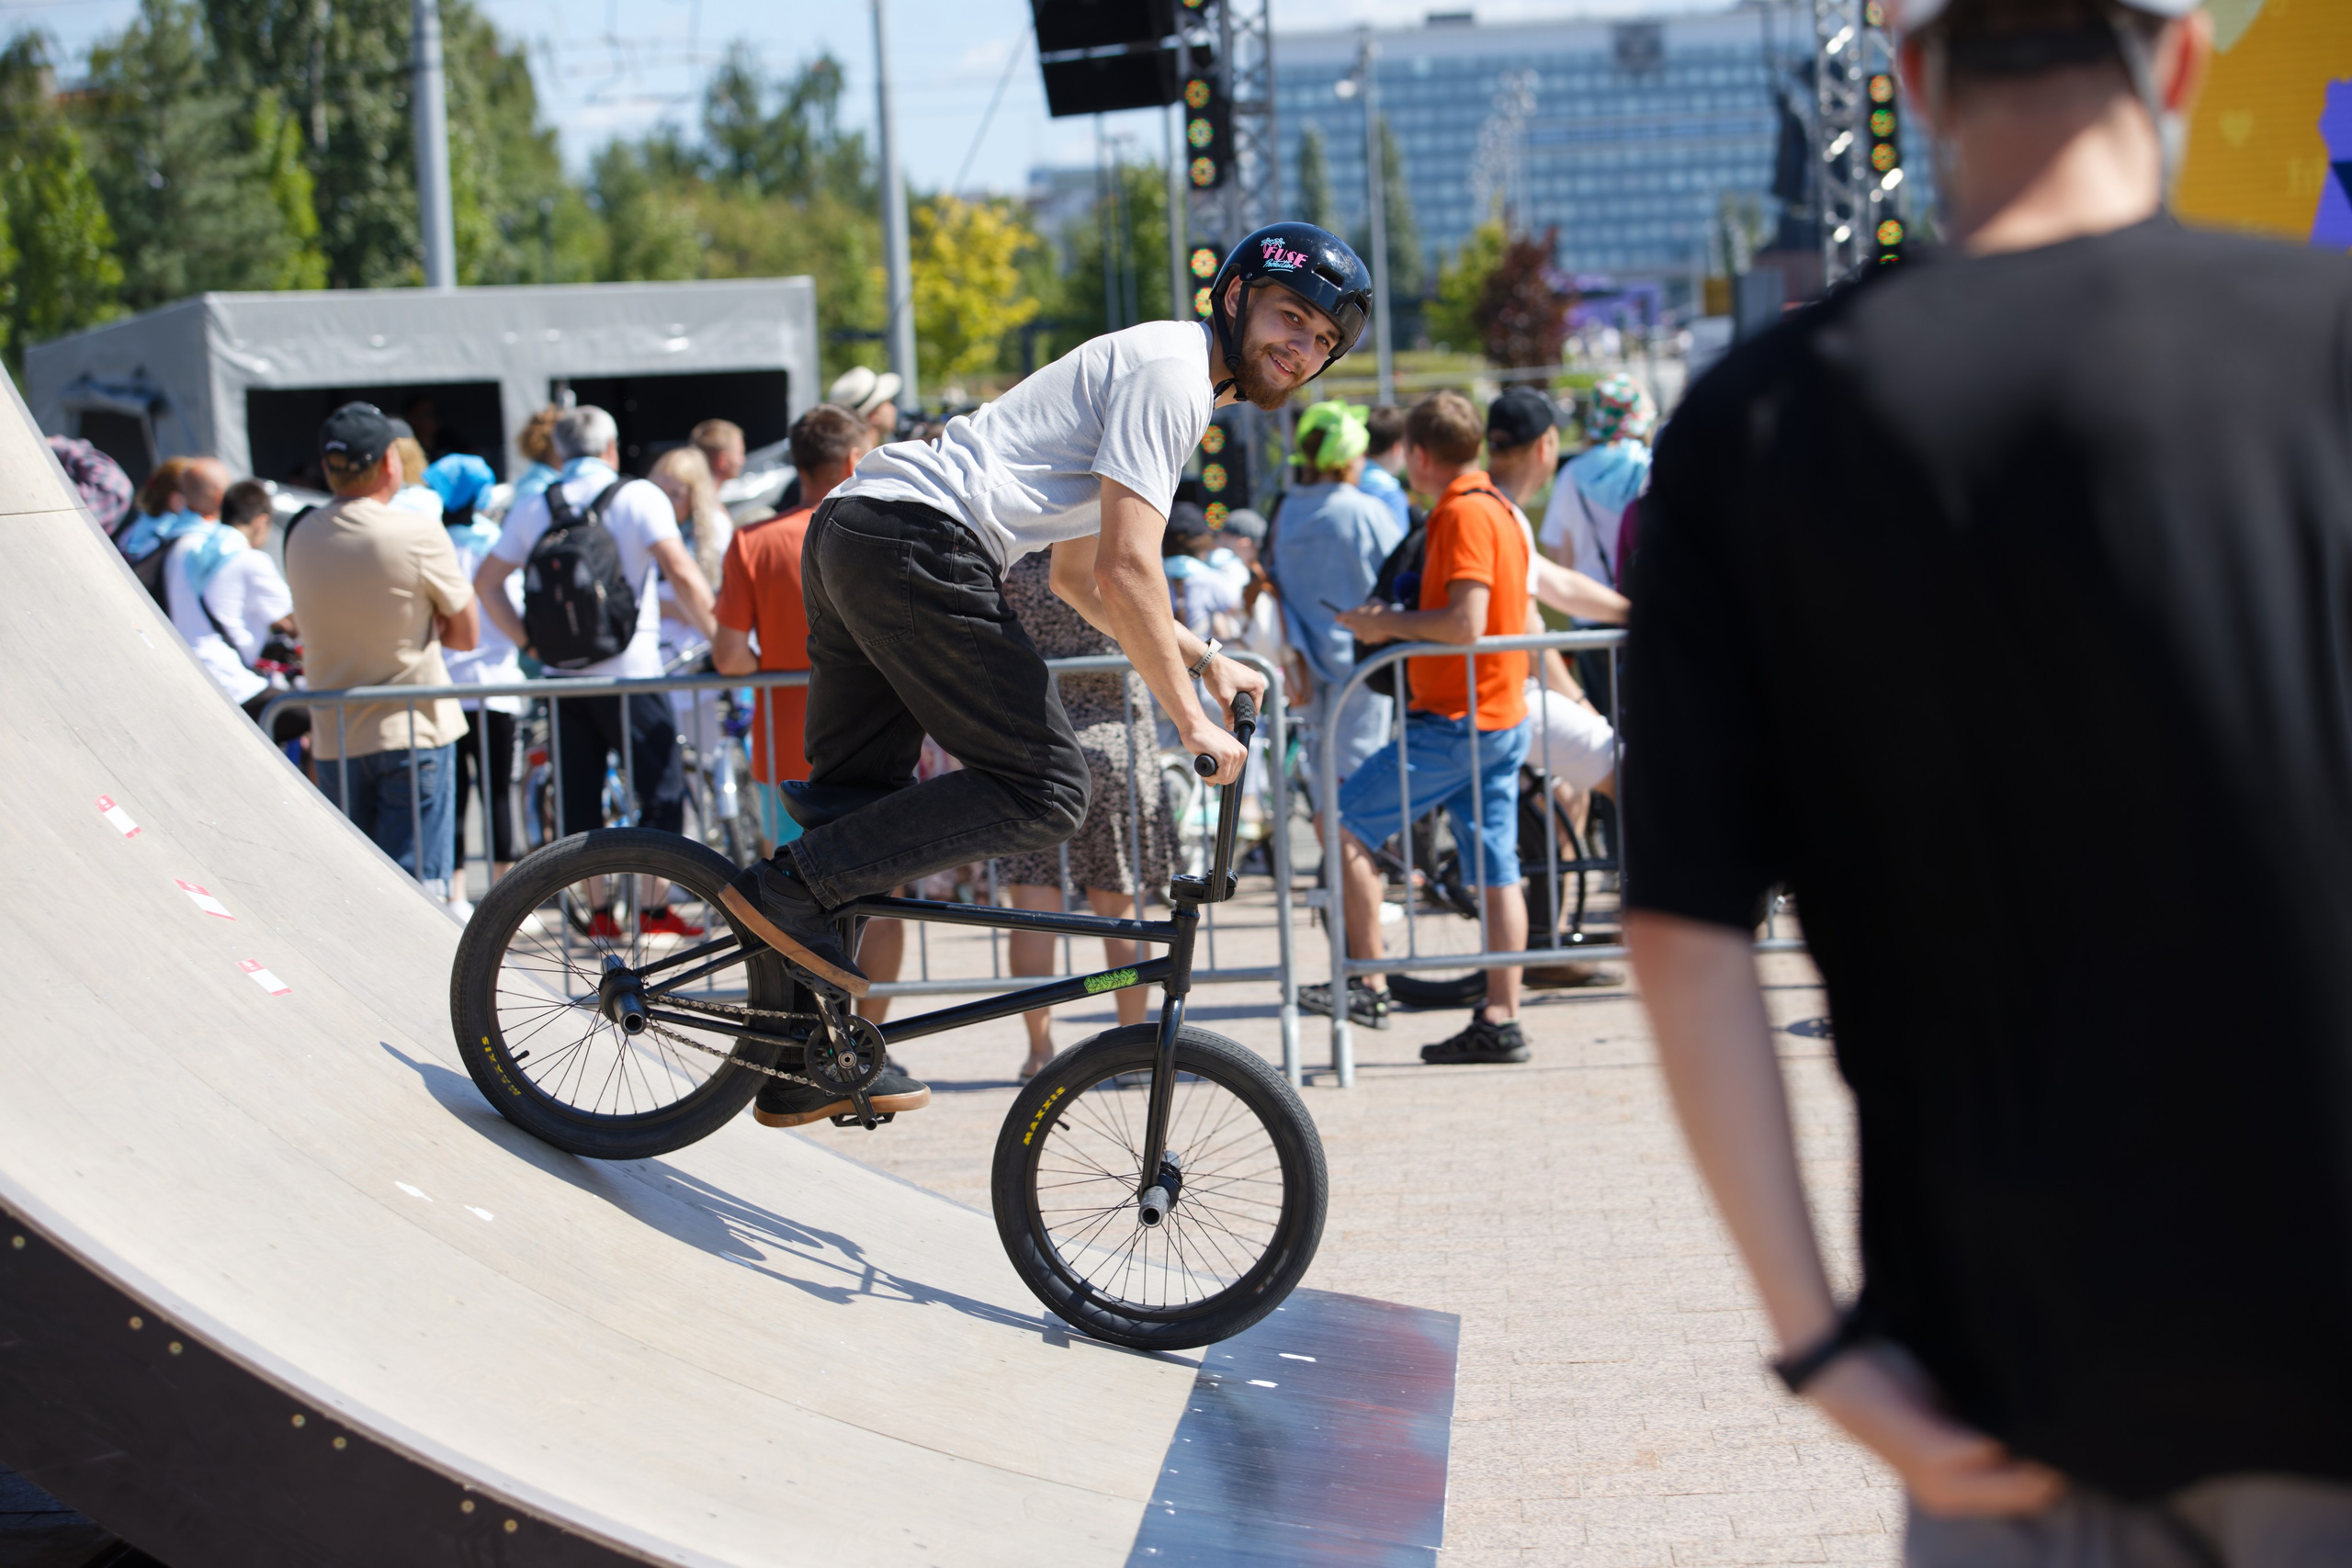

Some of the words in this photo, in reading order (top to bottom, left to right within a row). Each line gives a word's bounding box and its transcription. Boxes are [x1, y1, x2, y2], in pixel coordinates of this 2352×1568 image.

[1263, 245, 1308, 268] FUSE
[481, 1036, 522, 1096] MAXXIS
[1023, 1086, 1066, 1146] MAXXIS
